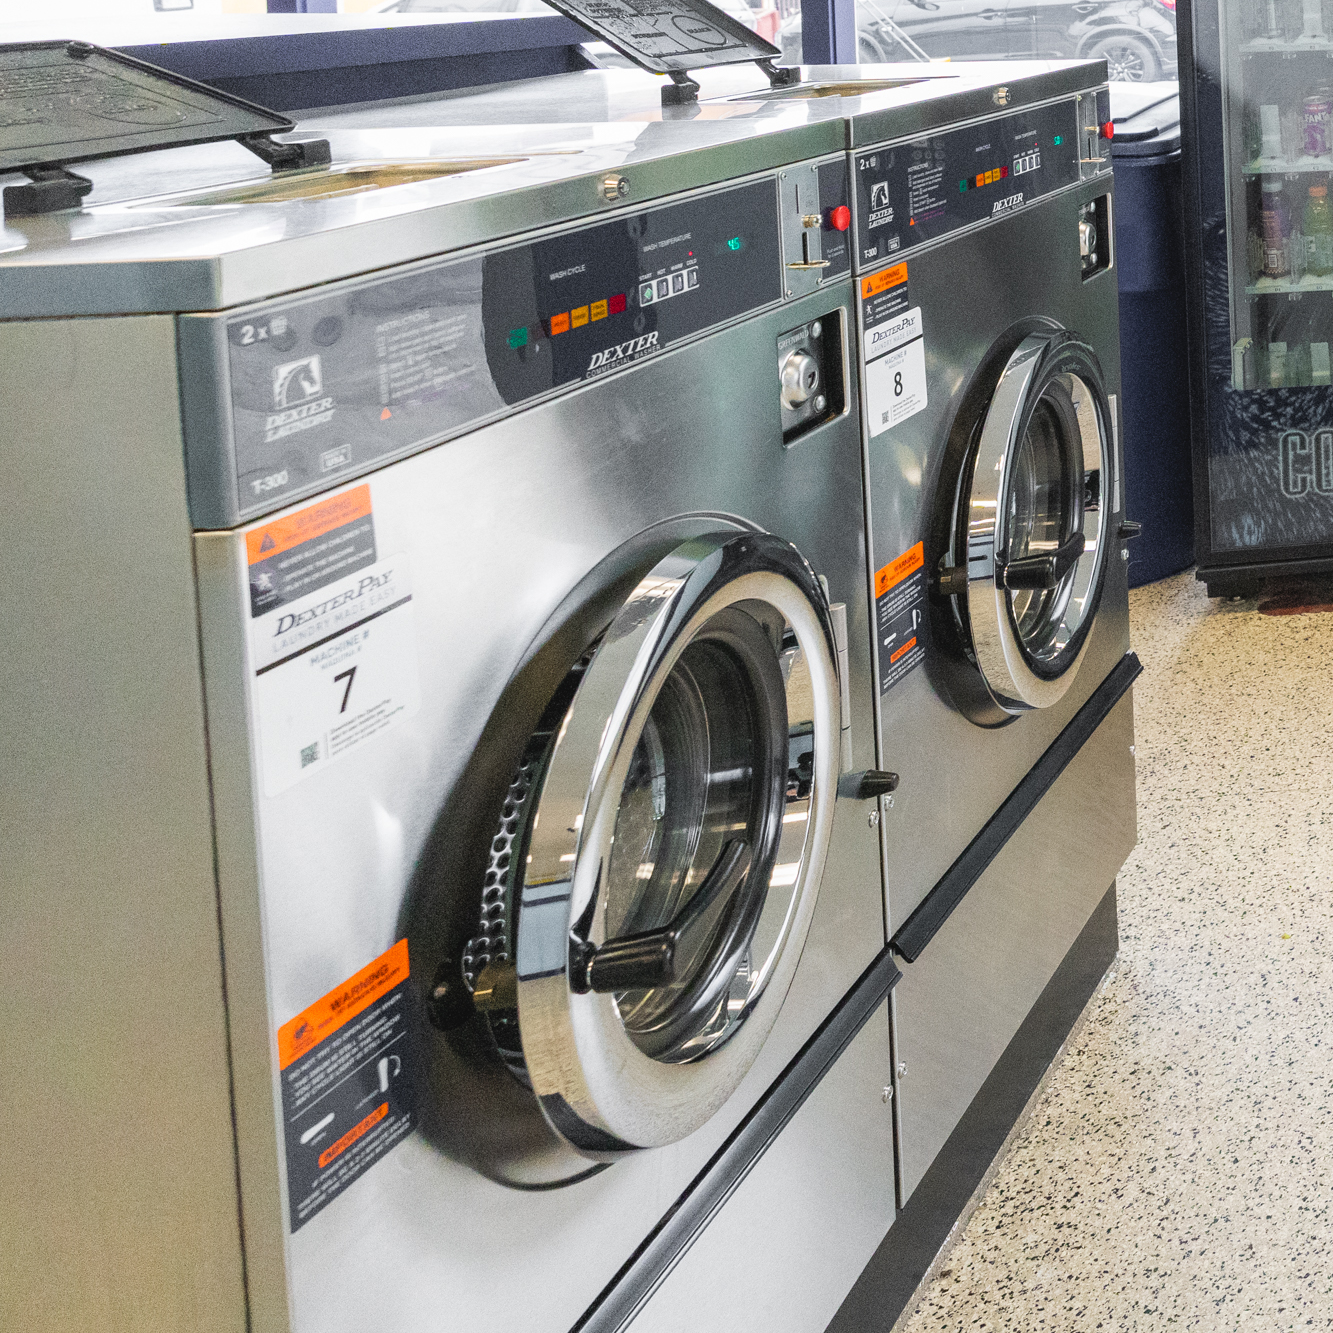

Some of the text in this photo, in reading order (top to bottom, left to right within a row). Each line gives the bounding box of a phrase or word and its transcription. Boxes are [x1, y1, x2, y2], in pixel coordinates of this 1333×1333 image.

[860, 159, 865, 170] 2
[992, 193, 1023, 212] DEXTER
[869, 208, 893, 222] DEXTER
[643, 232, 692, 253] WASH TEMPERATURE
[728, 237, 741, 250] 45
[864, 247, 877, 258] T-300
[550, 264, 586, 280] WASH CYCLE
[639, 273, 652, 281] START
[241, 325, 254, 345] 2
[588, 331, 658, 370] DEXTER
[885, 353, 903, 365] MACHINE
[586, 344, 661, 379] COMMERCIAL WASHER
[894, 372, 903, 396] 8
[265, 397, 336, 430] DEXTER
[251, 469, 289, 494] T-300
[309, 633, 360, 666] MACHINE
[333, 665, 358, 714] 7
